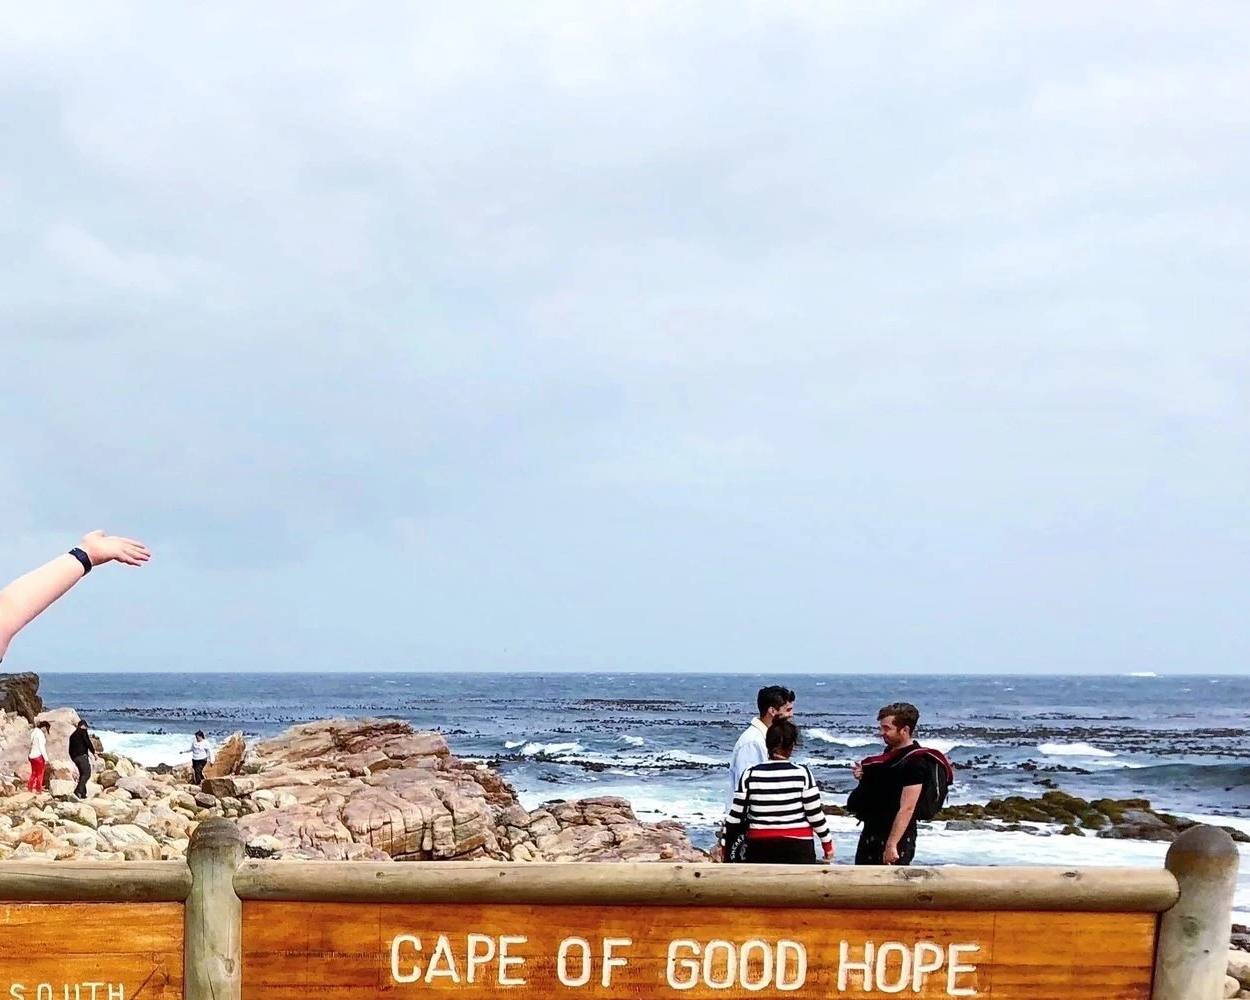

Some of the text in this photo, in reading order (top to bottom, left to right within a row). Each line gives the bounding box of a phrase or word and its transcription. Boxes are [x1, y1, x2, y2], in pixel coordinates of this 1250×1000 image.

[388, 934, 981, 996] CAPE OF GOOD HOPE
